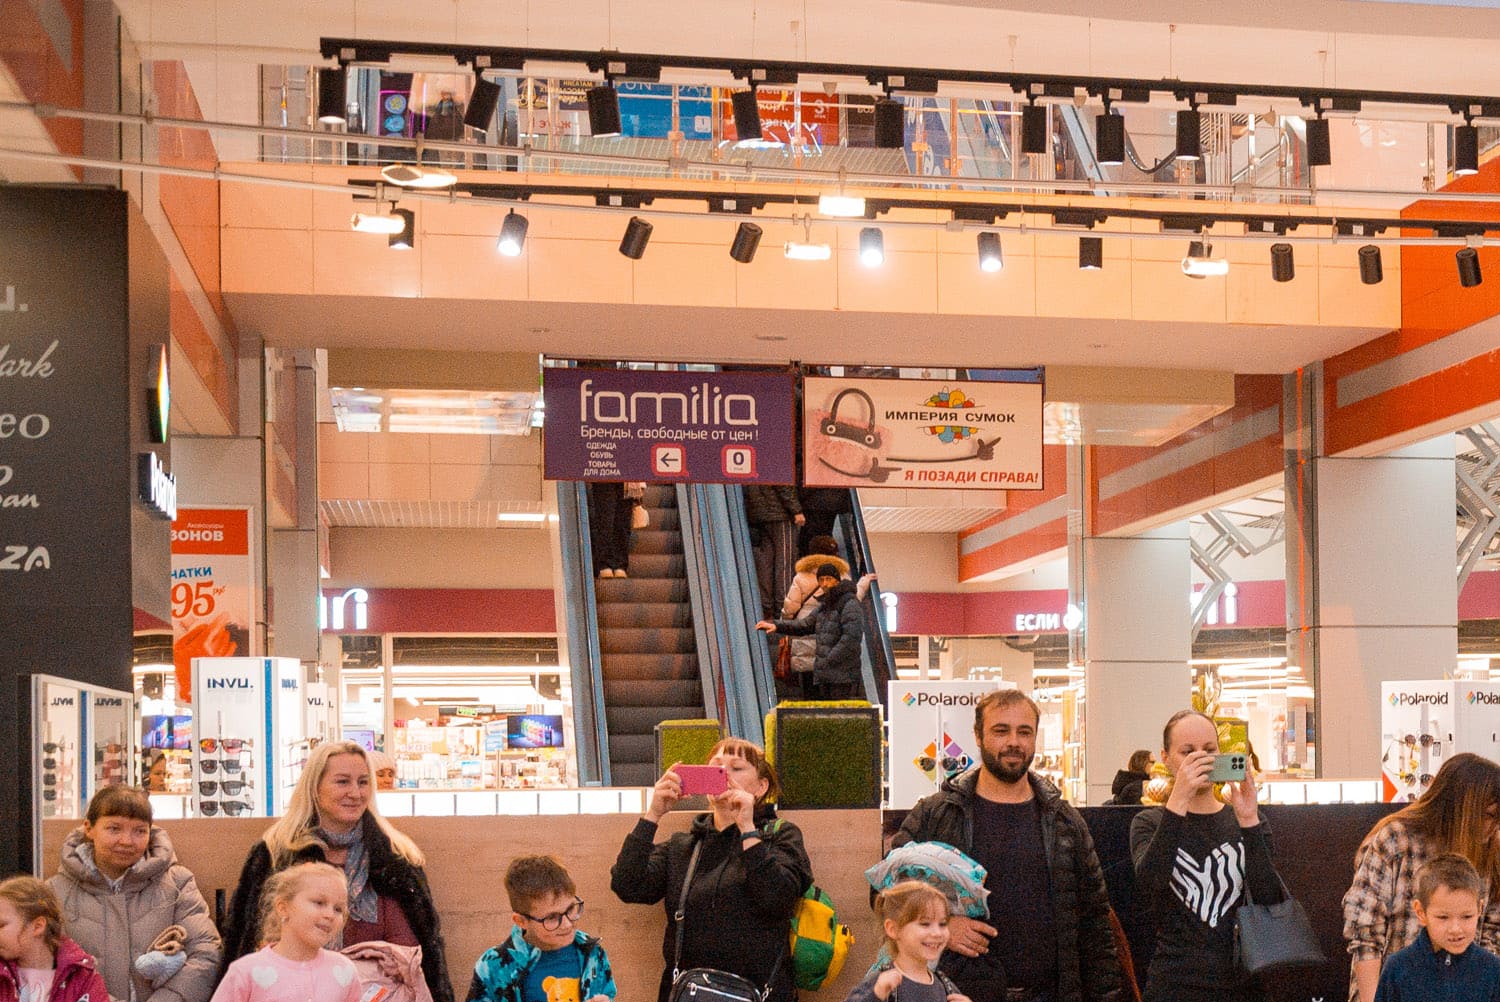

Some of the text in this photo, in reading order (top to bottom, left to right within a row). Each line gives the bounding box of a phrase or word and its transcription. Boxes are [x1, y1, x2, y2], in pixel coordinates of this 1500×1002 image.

[580, 379, 759, 427] familia
[885, 410, 1016, 423] ИМПЕРИЯ СУМОК
[580, 425, 634, 441] Бренды,
[637, 427, 708, 441] свободные
[711, 431, 726, 441] от
[585, 441, 617, 450] ОДЕЖДА
[589, 452, 614, 460] ОБУВЬ
[733, 451, 745, 466] 0
[587, 461, 617, 469] ТОВАРЫ
[583, 469, 621, 477] ДЛЯ ДОМА
[904, 469, 1039, 484] Я ПОЗАДИ СПРАВА!
[1015, 613, 1060, 631] ЕСЛИ
[207, 678, 254, 689] INVU.
[1399, 692, 1449, 705] Polaroid
